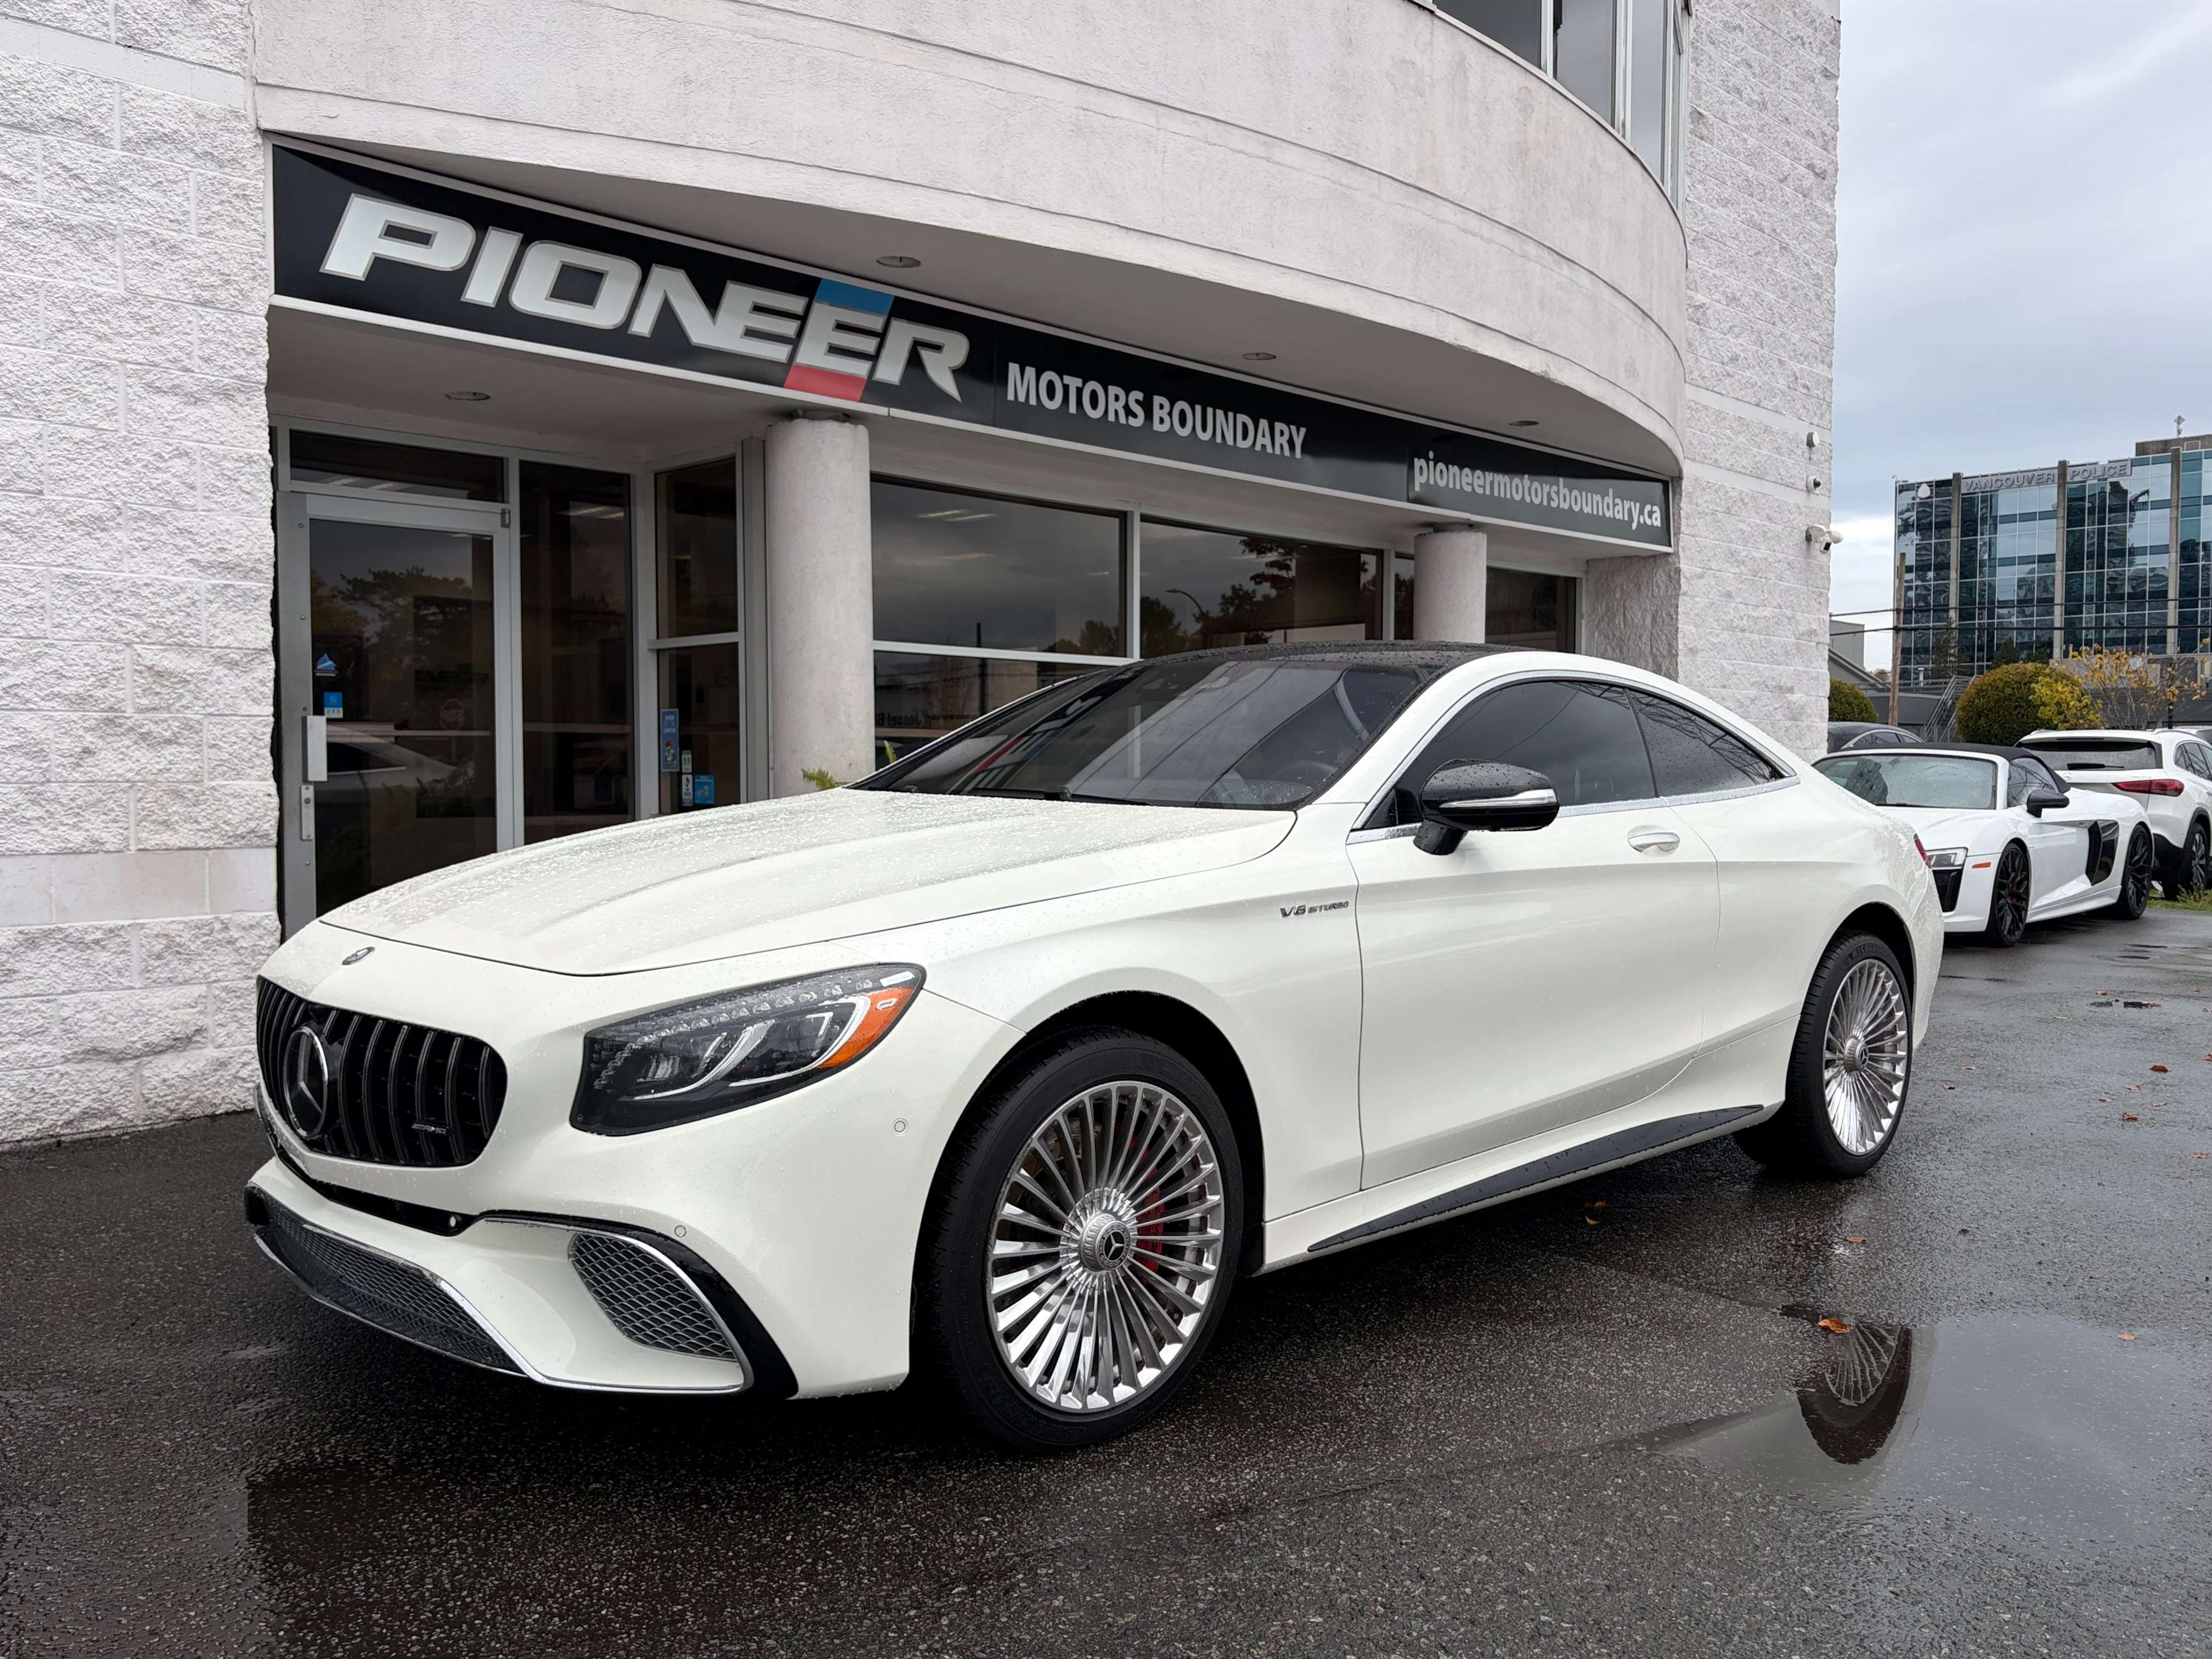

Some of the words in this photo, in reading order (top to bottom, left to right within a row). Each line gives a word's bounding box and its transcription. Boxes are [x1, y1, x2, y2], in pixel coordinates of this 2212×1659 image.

[319, 193, 969, 403] PIONEER
[1007, 362, 1145, 428] MOTORS
[1153, 396, 1307, 459] BOUNDARY
[1413, 450, 1661, 531] pioneermotorsboundary.ca
[1963, 472, 2055, 492] VANCOUVER
[2070, 464, 2127, 479] POLICE
[1280, 905, 1306, 917] V8
